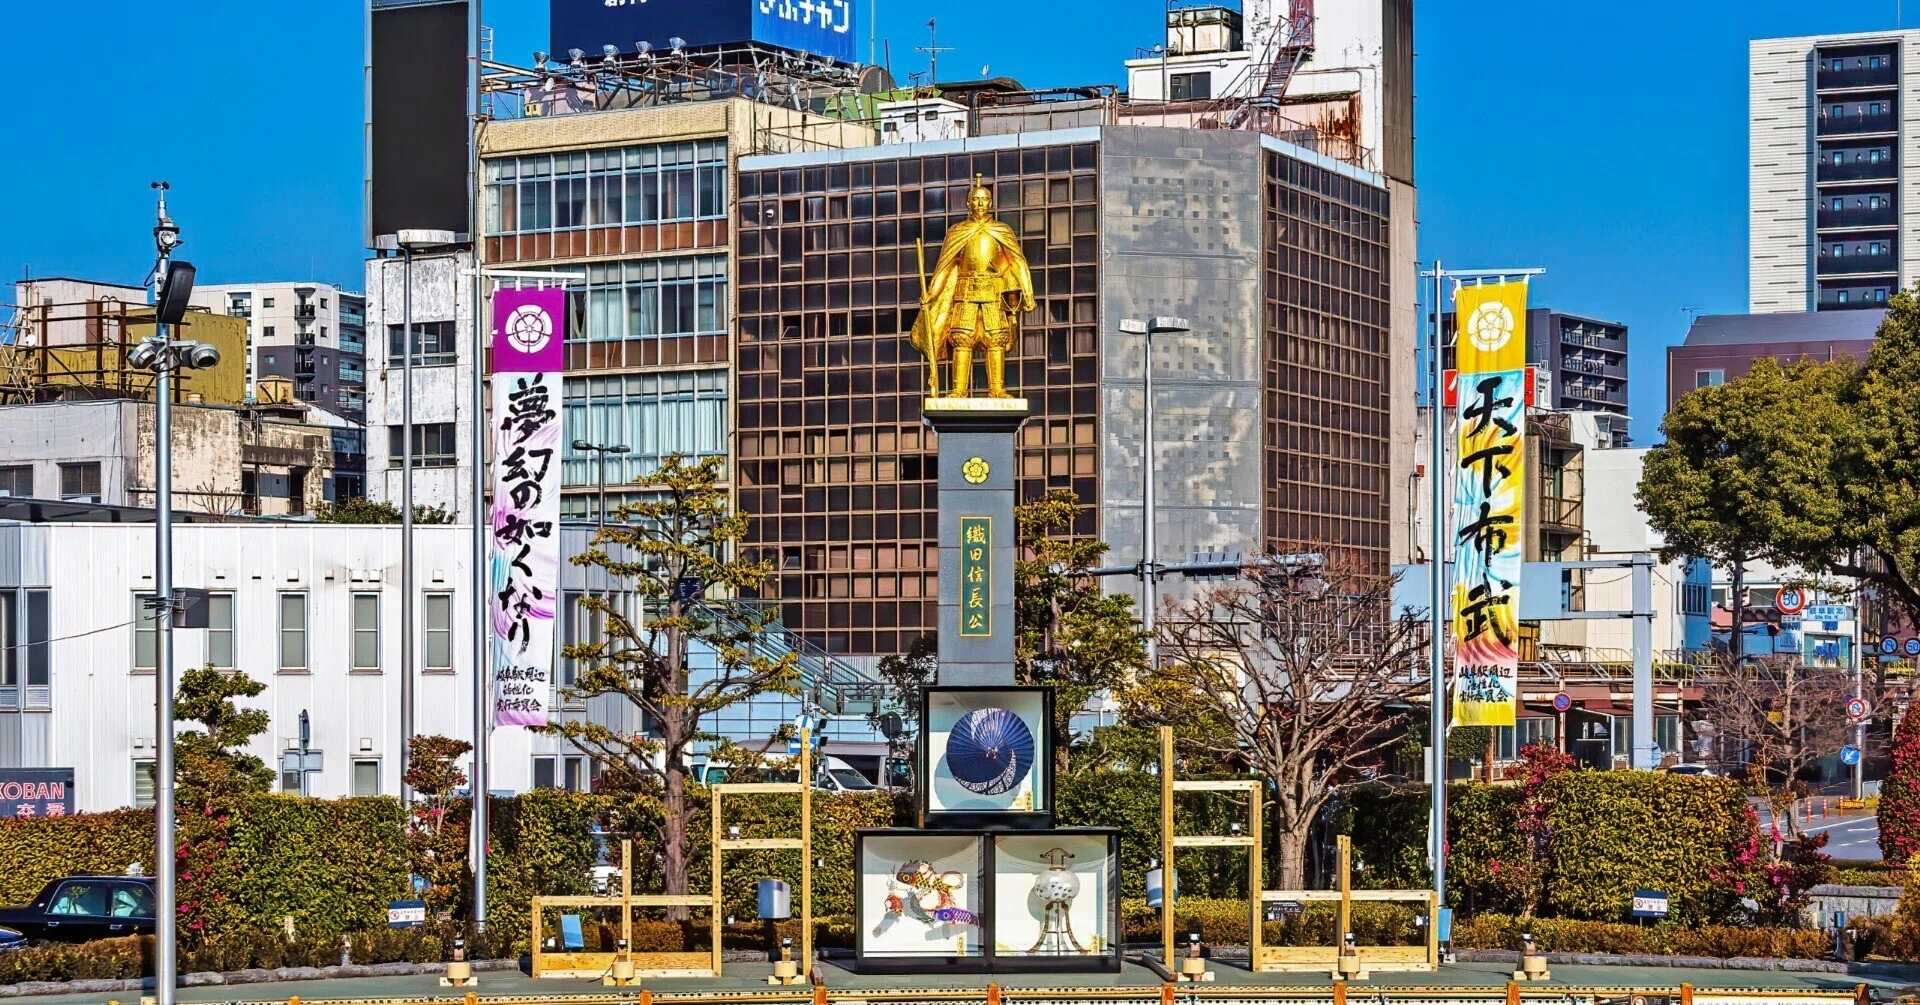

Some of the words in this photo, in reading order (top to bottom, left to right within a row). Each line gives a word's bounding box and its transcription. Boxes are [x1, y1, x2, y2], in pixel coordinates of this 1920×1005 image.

[495, 371, 556, 656] 夢幻の如くなり
[1458, 375, 1517, 647] 天下布武
[966, 524, 987, 630] 織田信長公
[1783, 592, 1799, 606] 50
[1907, 641, 1919, 652] 50
